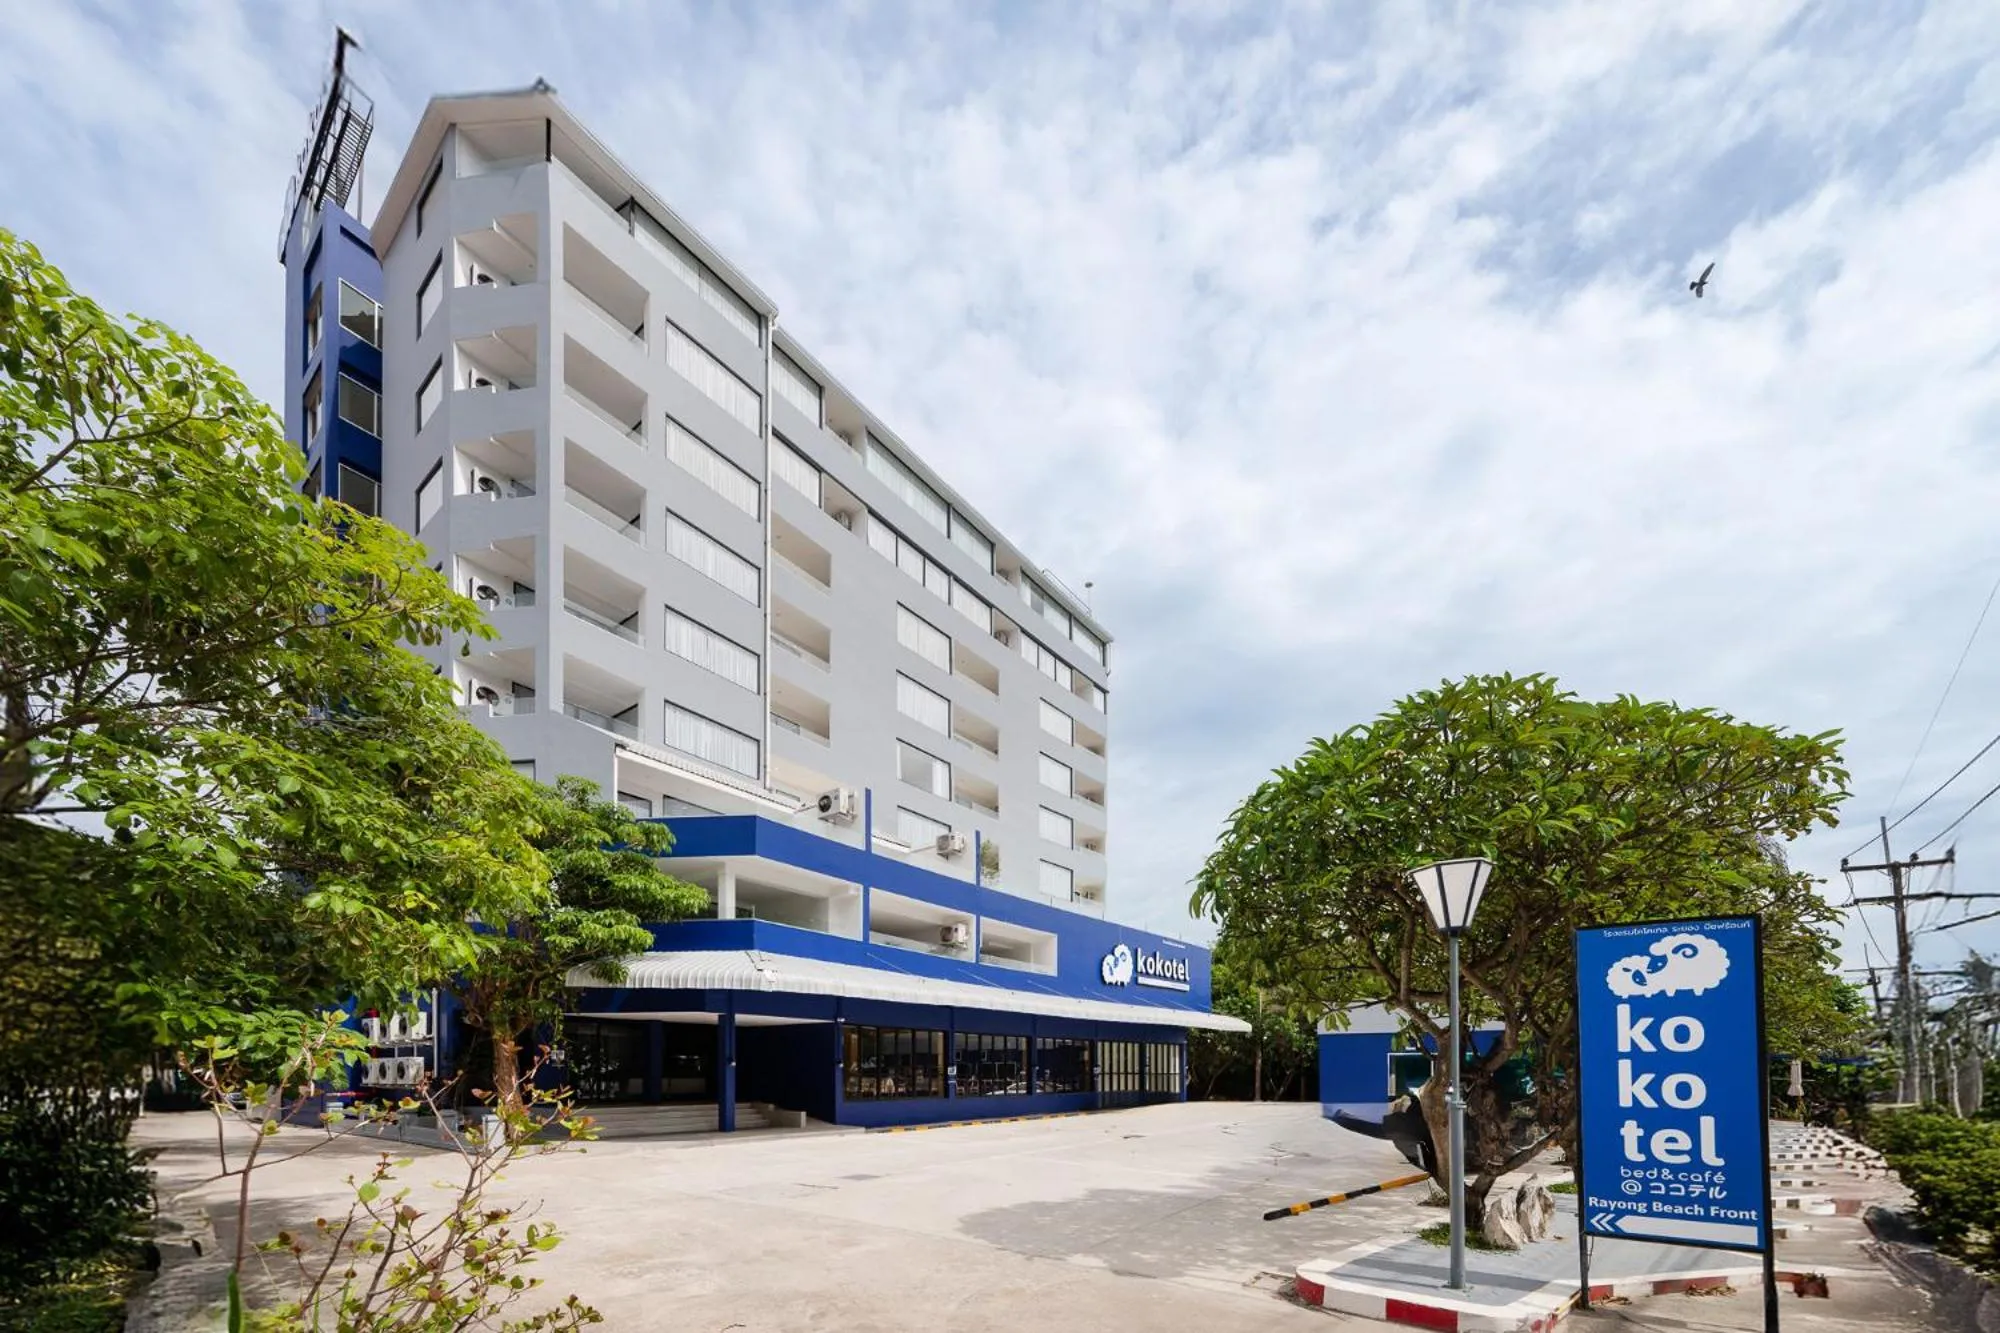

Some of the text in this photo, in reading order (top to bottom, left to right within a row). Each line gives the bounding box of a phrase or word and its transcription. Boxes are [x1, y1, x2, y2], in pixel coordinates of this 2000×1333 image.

[1137, 947, 1190, 981] kokotel
[1616, 1003, 1705, 1053] ko
[1617, 1059, 1707, 1109] ko
[1620, 1115, 1725, 1166] tel
[1588, 1196, 1759, 1221] Rayong Beach Front
[1649, 1182, 1728, 1199] ココテル
